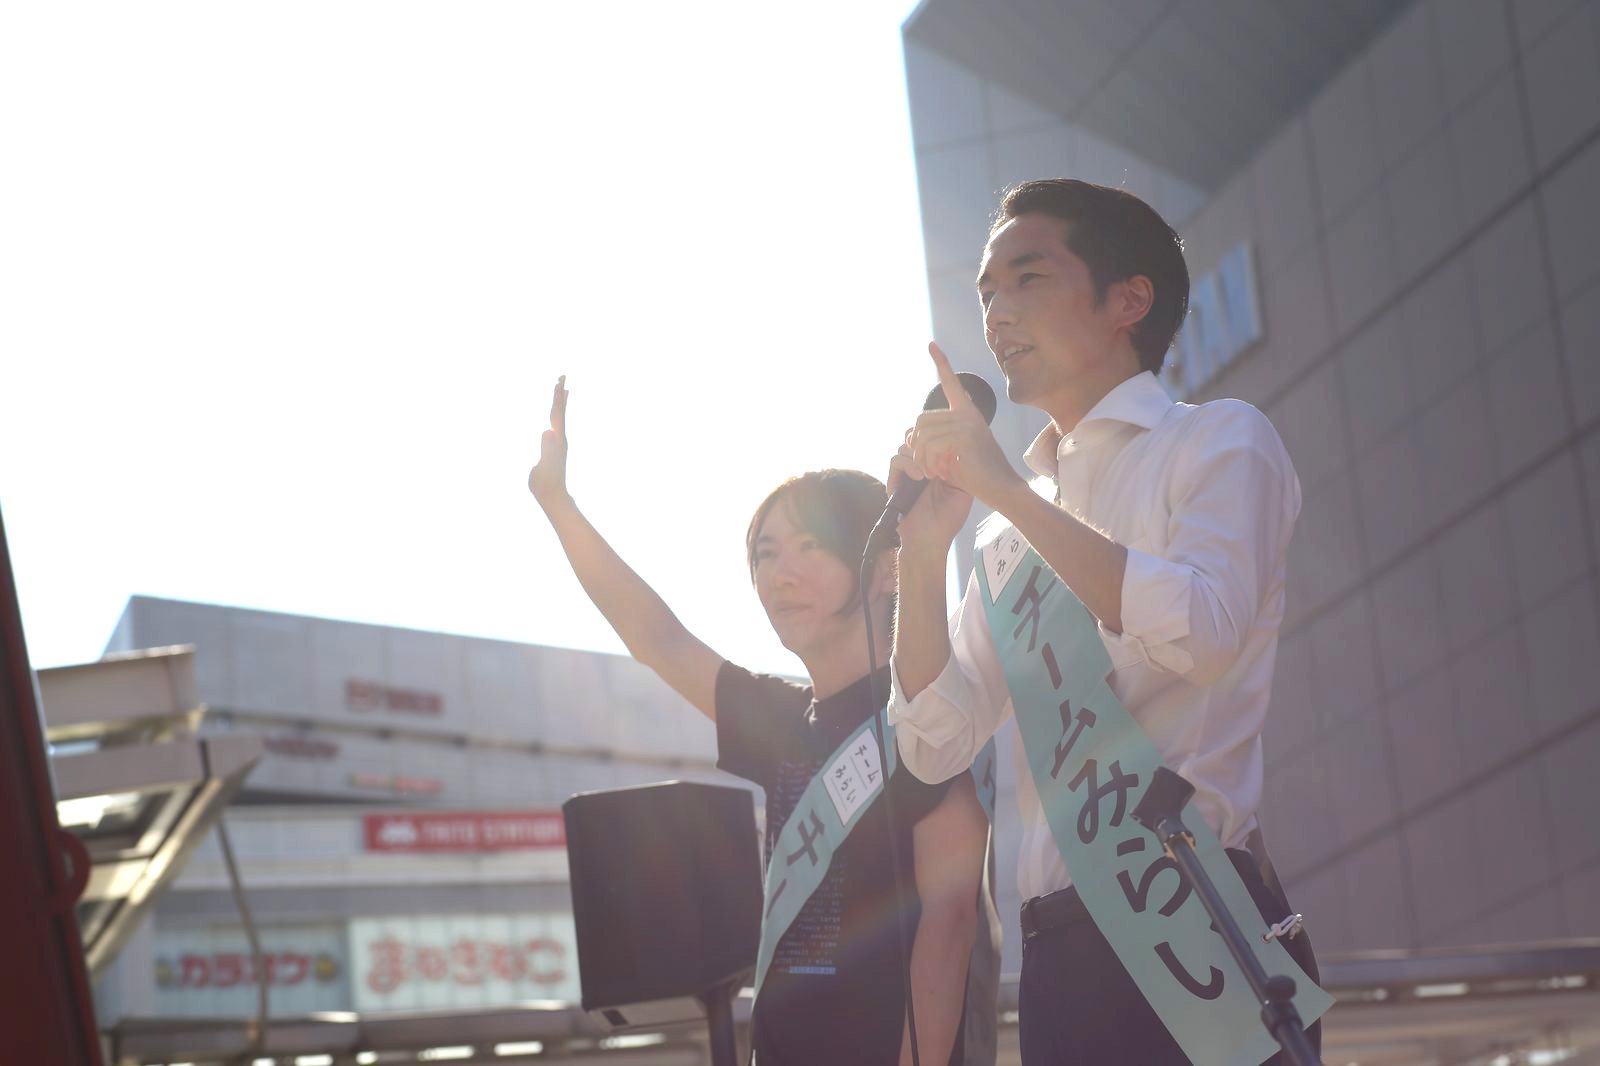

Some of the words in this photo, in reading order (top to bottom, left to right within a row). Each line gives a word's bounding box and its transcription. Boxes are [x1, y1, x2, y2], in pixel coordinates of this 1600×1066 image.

[855, 744, 880, 784] チーム
[835, 765, 857, 804] みらい
